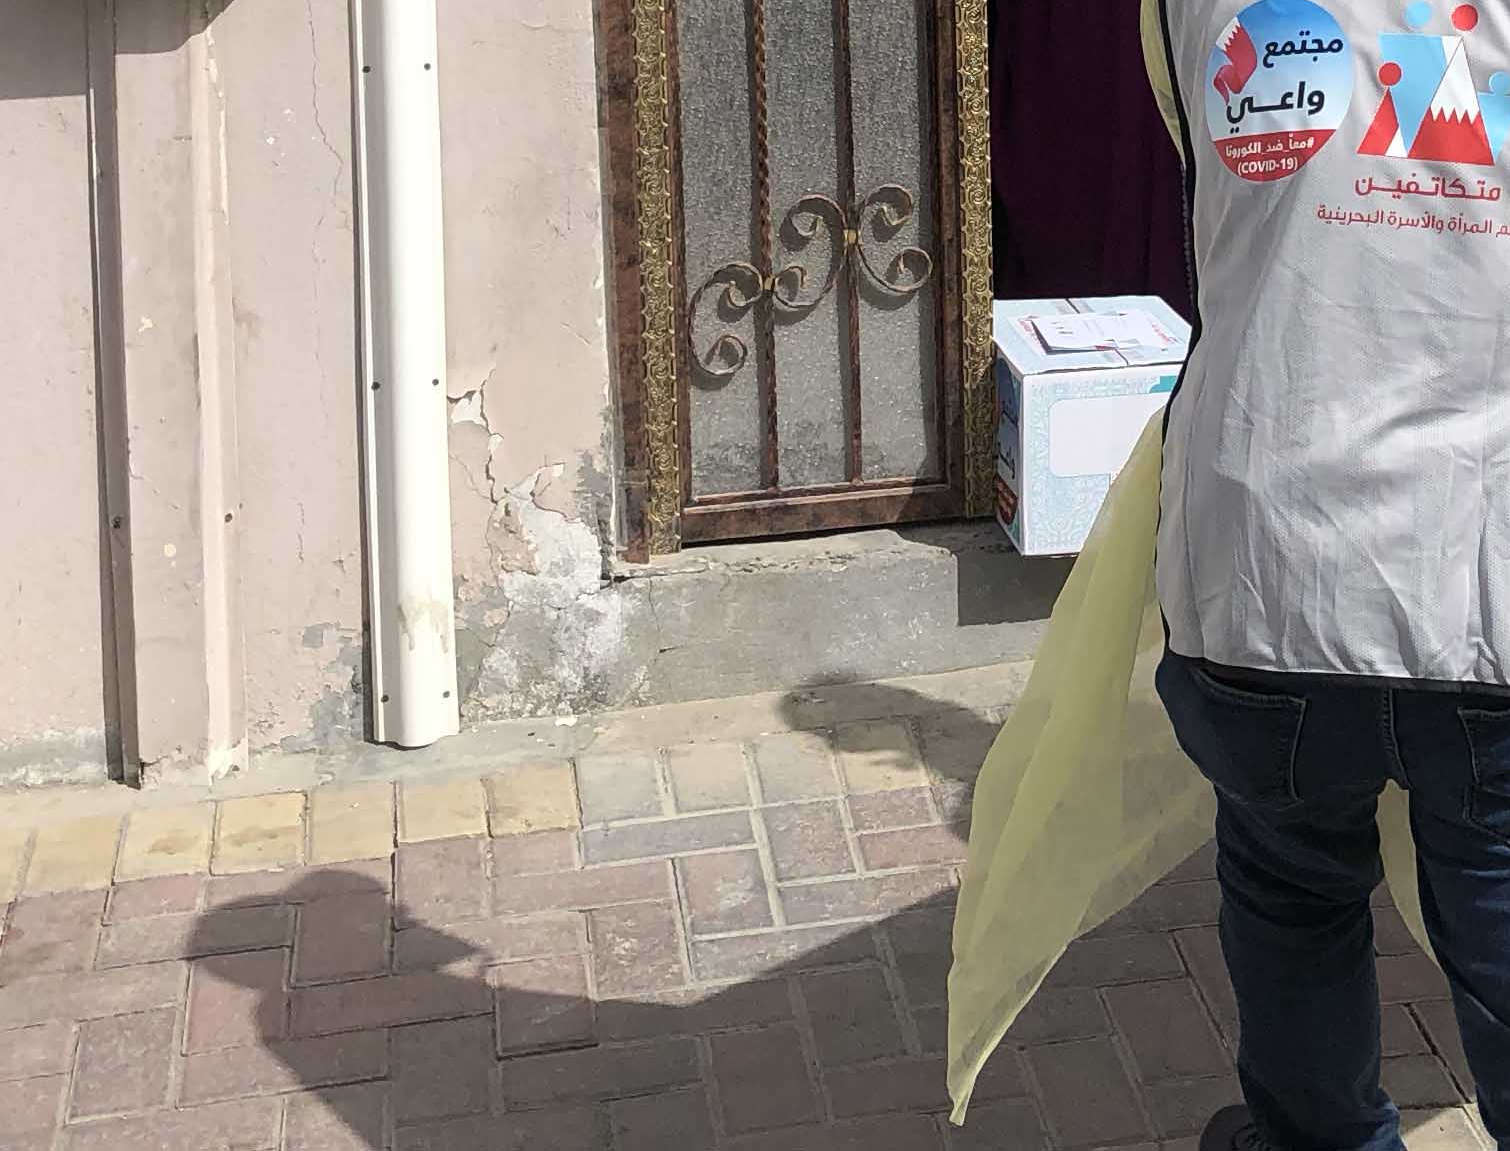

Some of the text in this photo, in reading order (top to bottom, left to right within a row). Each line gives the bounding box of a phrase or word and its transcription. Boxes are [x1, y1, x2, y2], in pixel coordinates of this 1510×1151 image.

[1262, 30, 1344, 68] مجتمع
[1226, 80, 1326, 134] واعي
[1237, 156, 1298, 176] (COVID-19)
[1354, 172, 1502, 201] متكاتفين
[1317, 203, 1384, 228] البحرينية
[1386, 210, 1445, 234] والأسرة
[1447, 212, 1493, 233] المرأة
